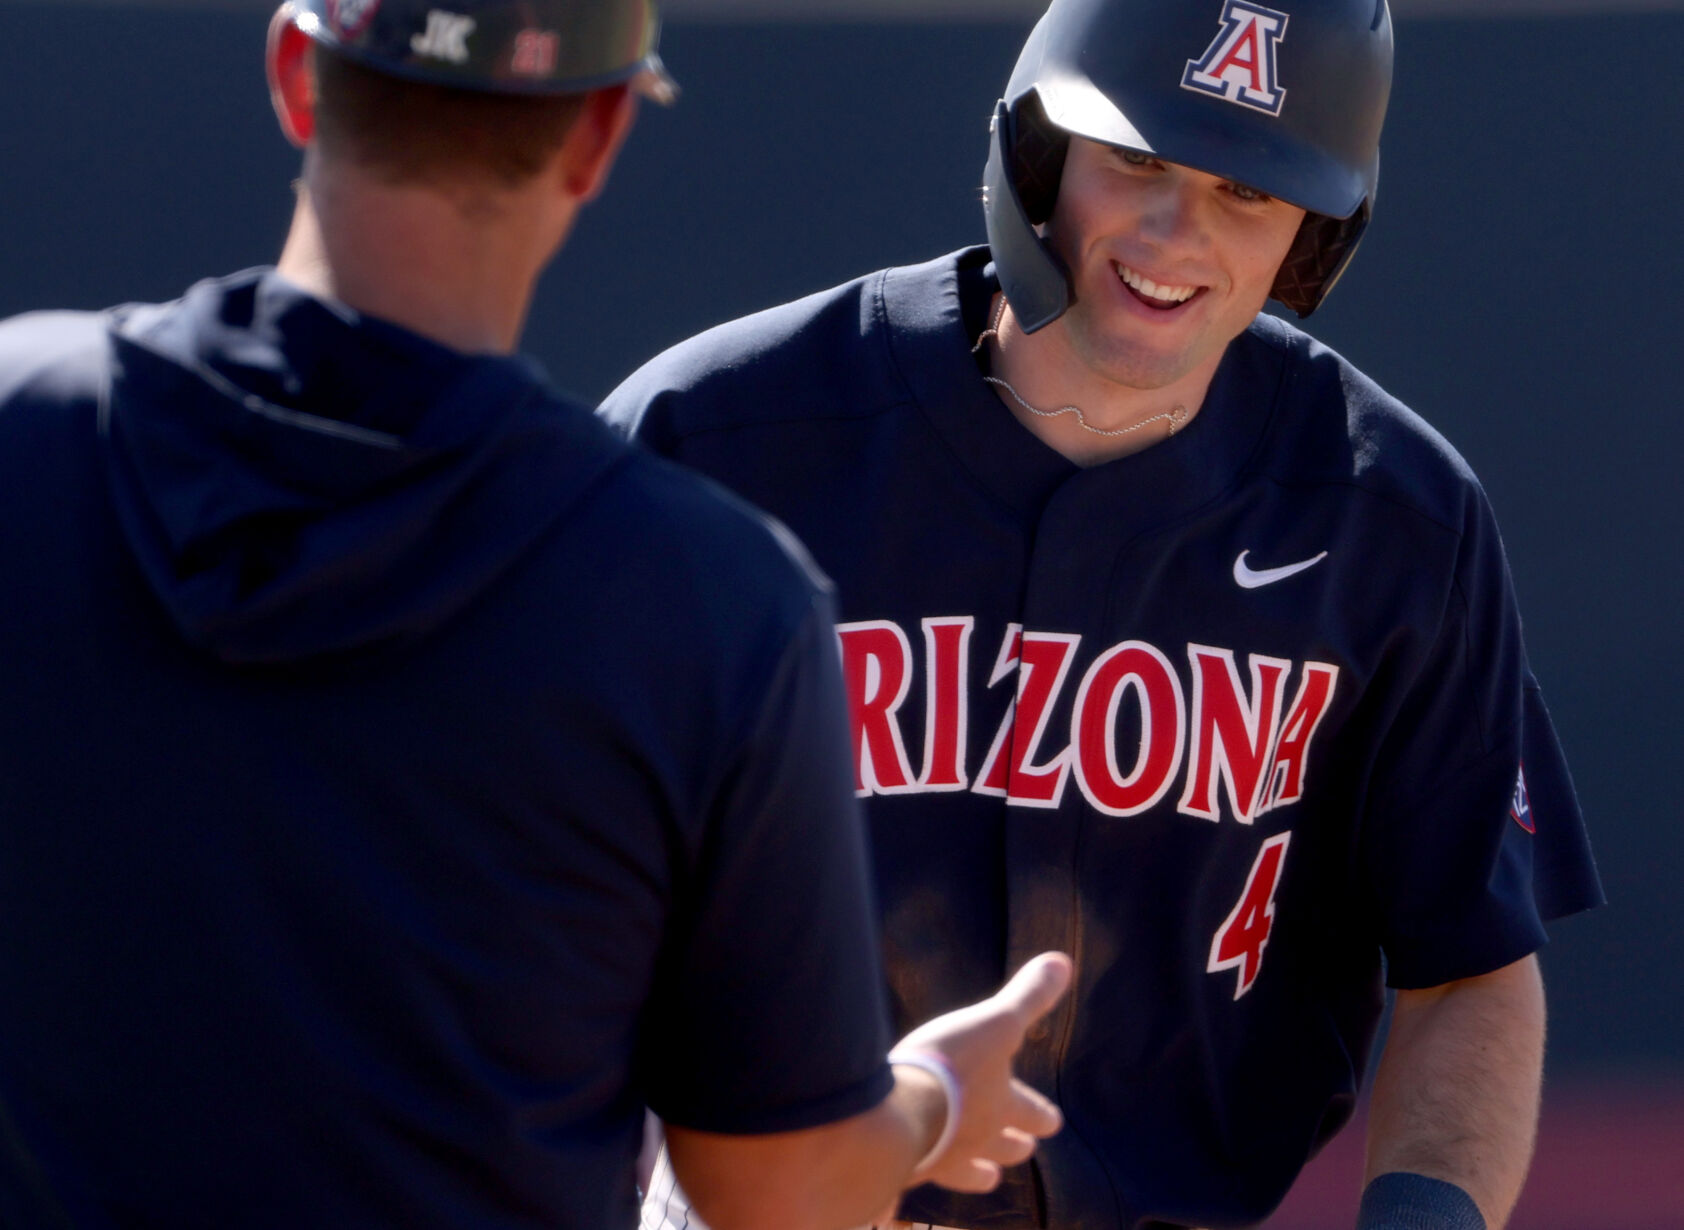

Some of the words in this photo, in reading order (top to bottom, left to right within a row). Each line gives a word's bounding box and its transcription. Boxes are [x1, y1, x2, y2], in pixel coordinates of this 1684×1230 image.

[410, 9, 476, 64] JK
[1179, 0, 1290, 117] A
[836, 616, 1339, 825] RIZONA
[1207, 831, 1291, 1000] 4
